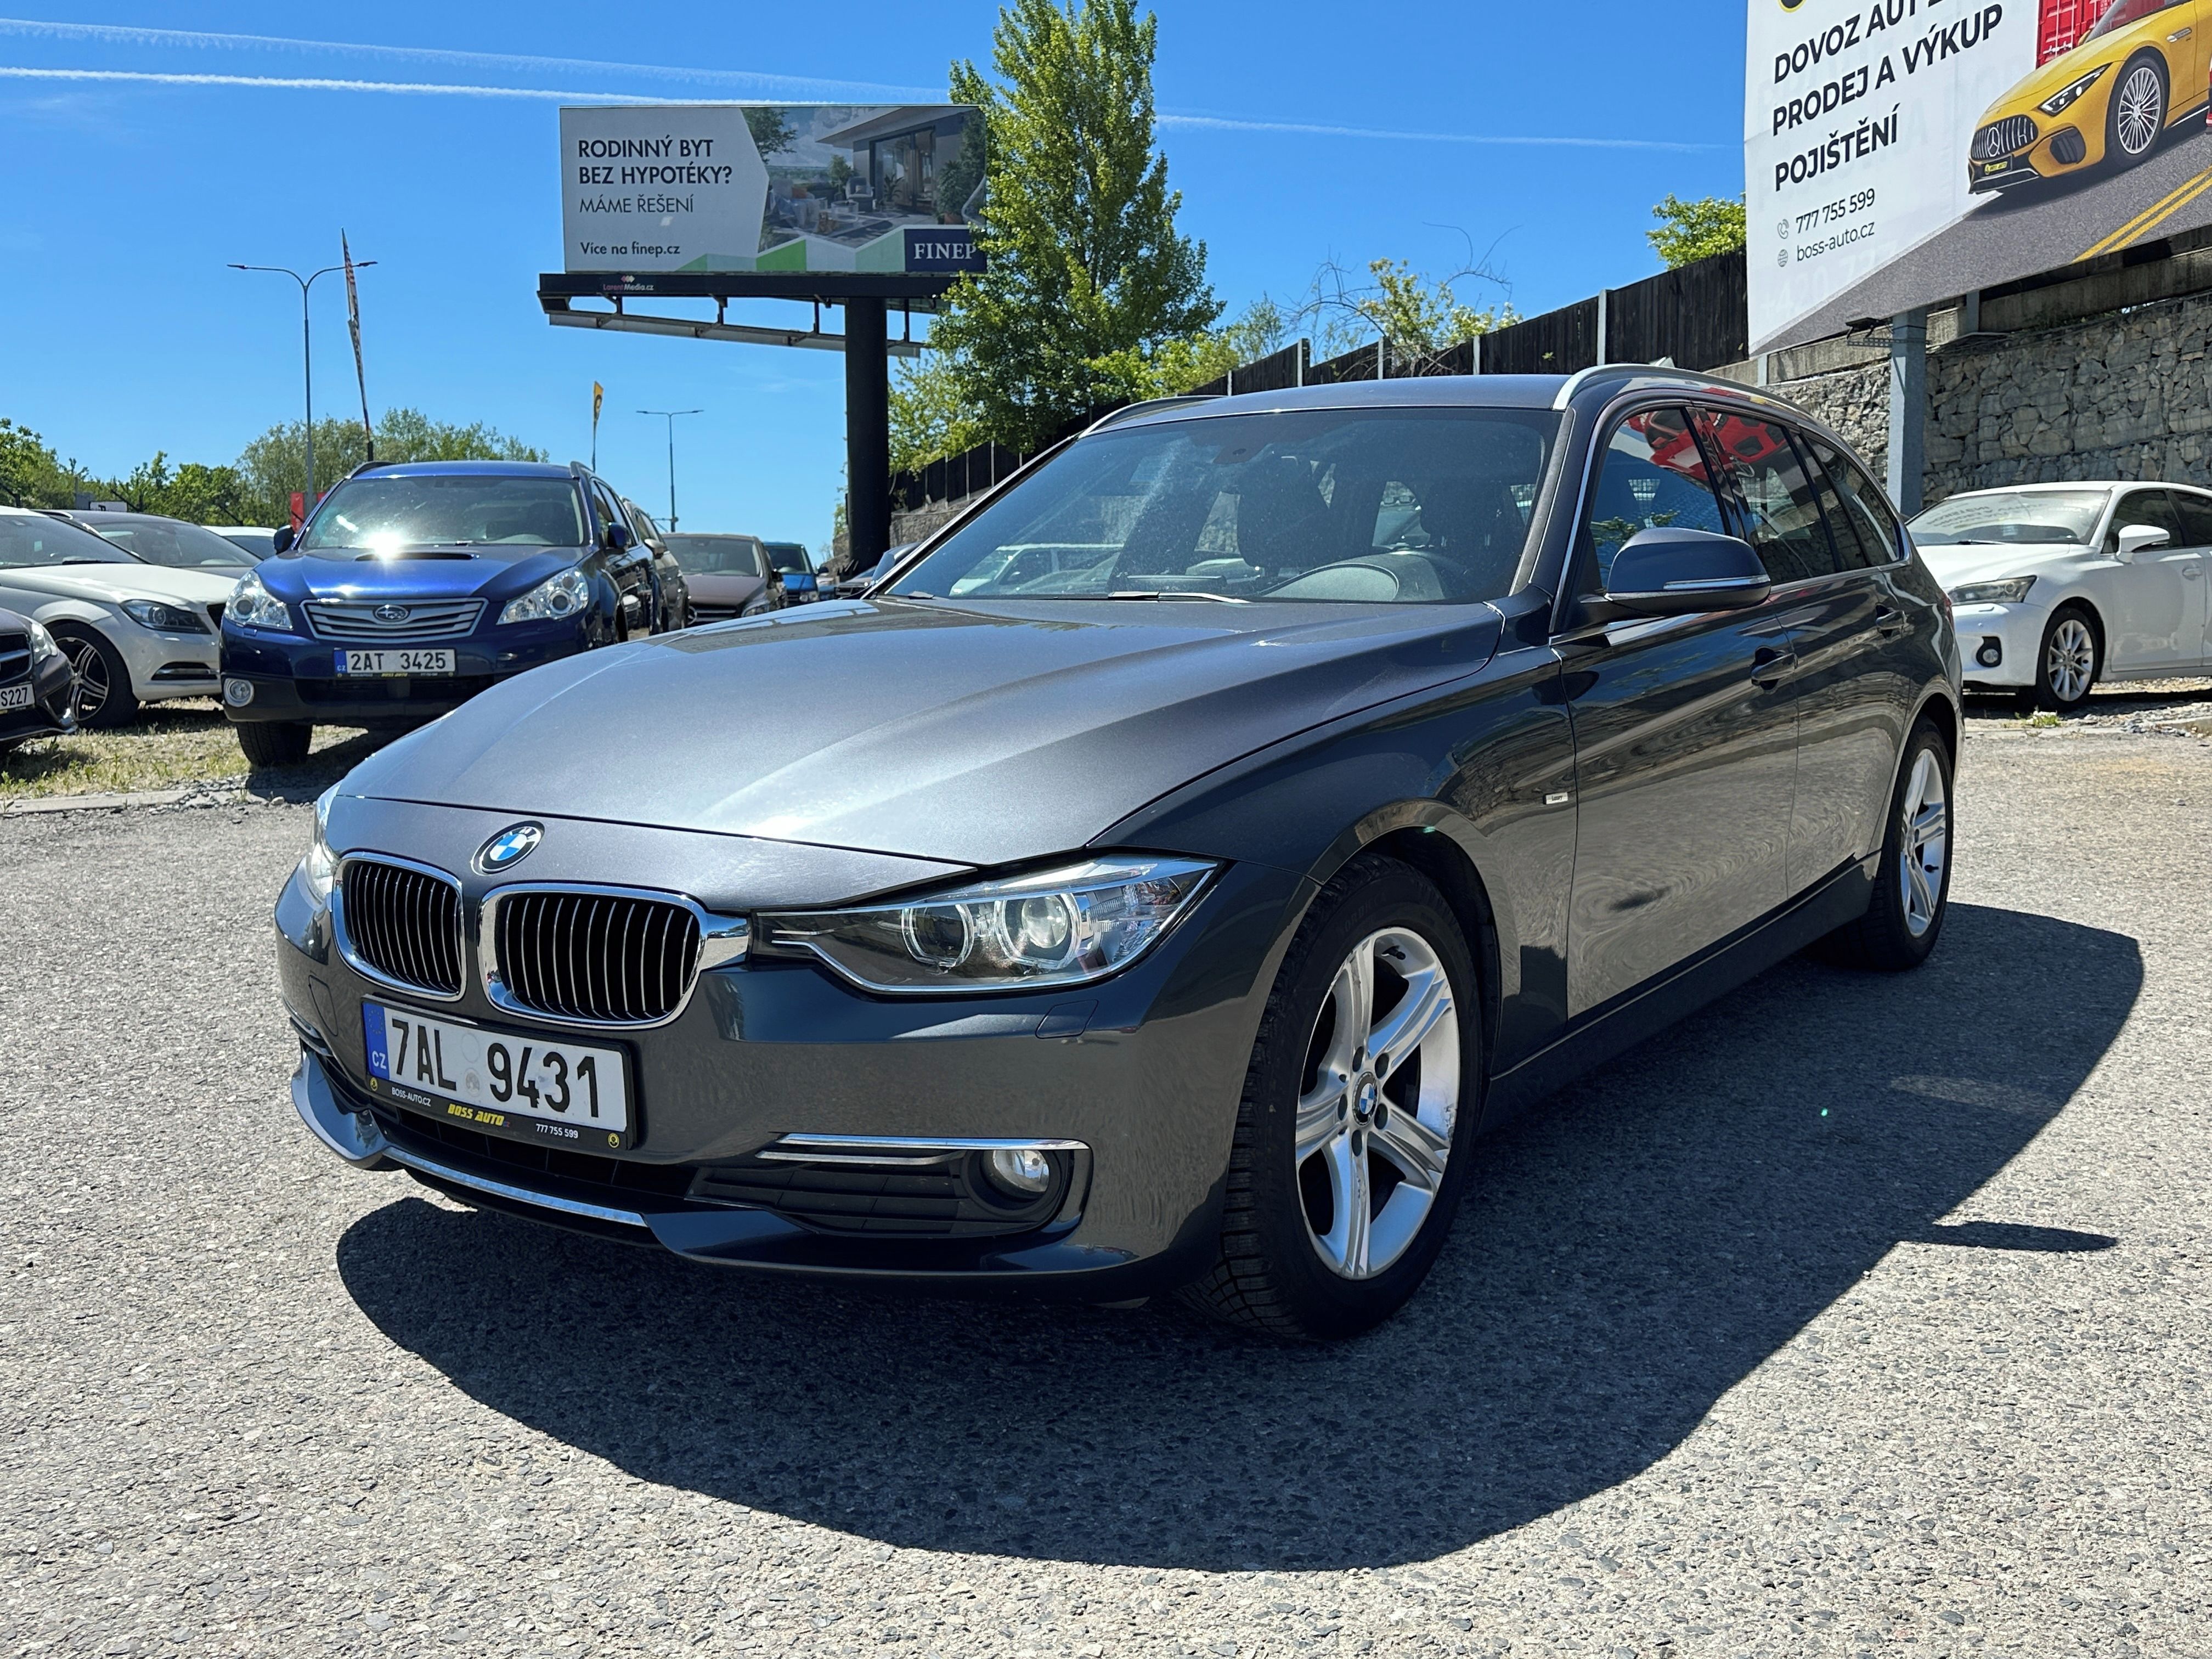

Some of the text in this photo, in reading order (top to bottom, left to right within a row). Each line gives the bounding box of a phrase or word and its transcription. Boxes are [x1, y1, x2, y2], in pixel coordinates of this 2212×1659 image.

[1774, 14, 1860, 84] DOVOZ
[1773, 4, 2002, 137] PRODEJ A VÝKUP
[578, 134, 714, 158] RODINNÝ BYT
[1775, 103, 1901, 192] POJIŠTĚNÍ
[579, 161, 732, 185] BEZ HYPOTÉKY?
[579, 193, 694, 213] MÁME ŘEŠENÍ
[1796, 188, 1875, 234] 777 755 599
[580, 241, 681, 258] Více na finep.cz
[913, 243, 977, 259] FINEP
[1797, 222, 1875, 262] boss-auto.cz
[351, 652, 446, 671] 2AT 3425
[372, 1049, 387, 1070] CZ
[392, 1018, 599, 1118] 7AL 9431
[391, 1086, 431, 1107] BOSS-AUTO.CZ
[448, 1103, 474, 1120] BOSS
[474, 1110, 505, 1127] AUTO
[535, 1123, 579, 1139] 777 755 599
